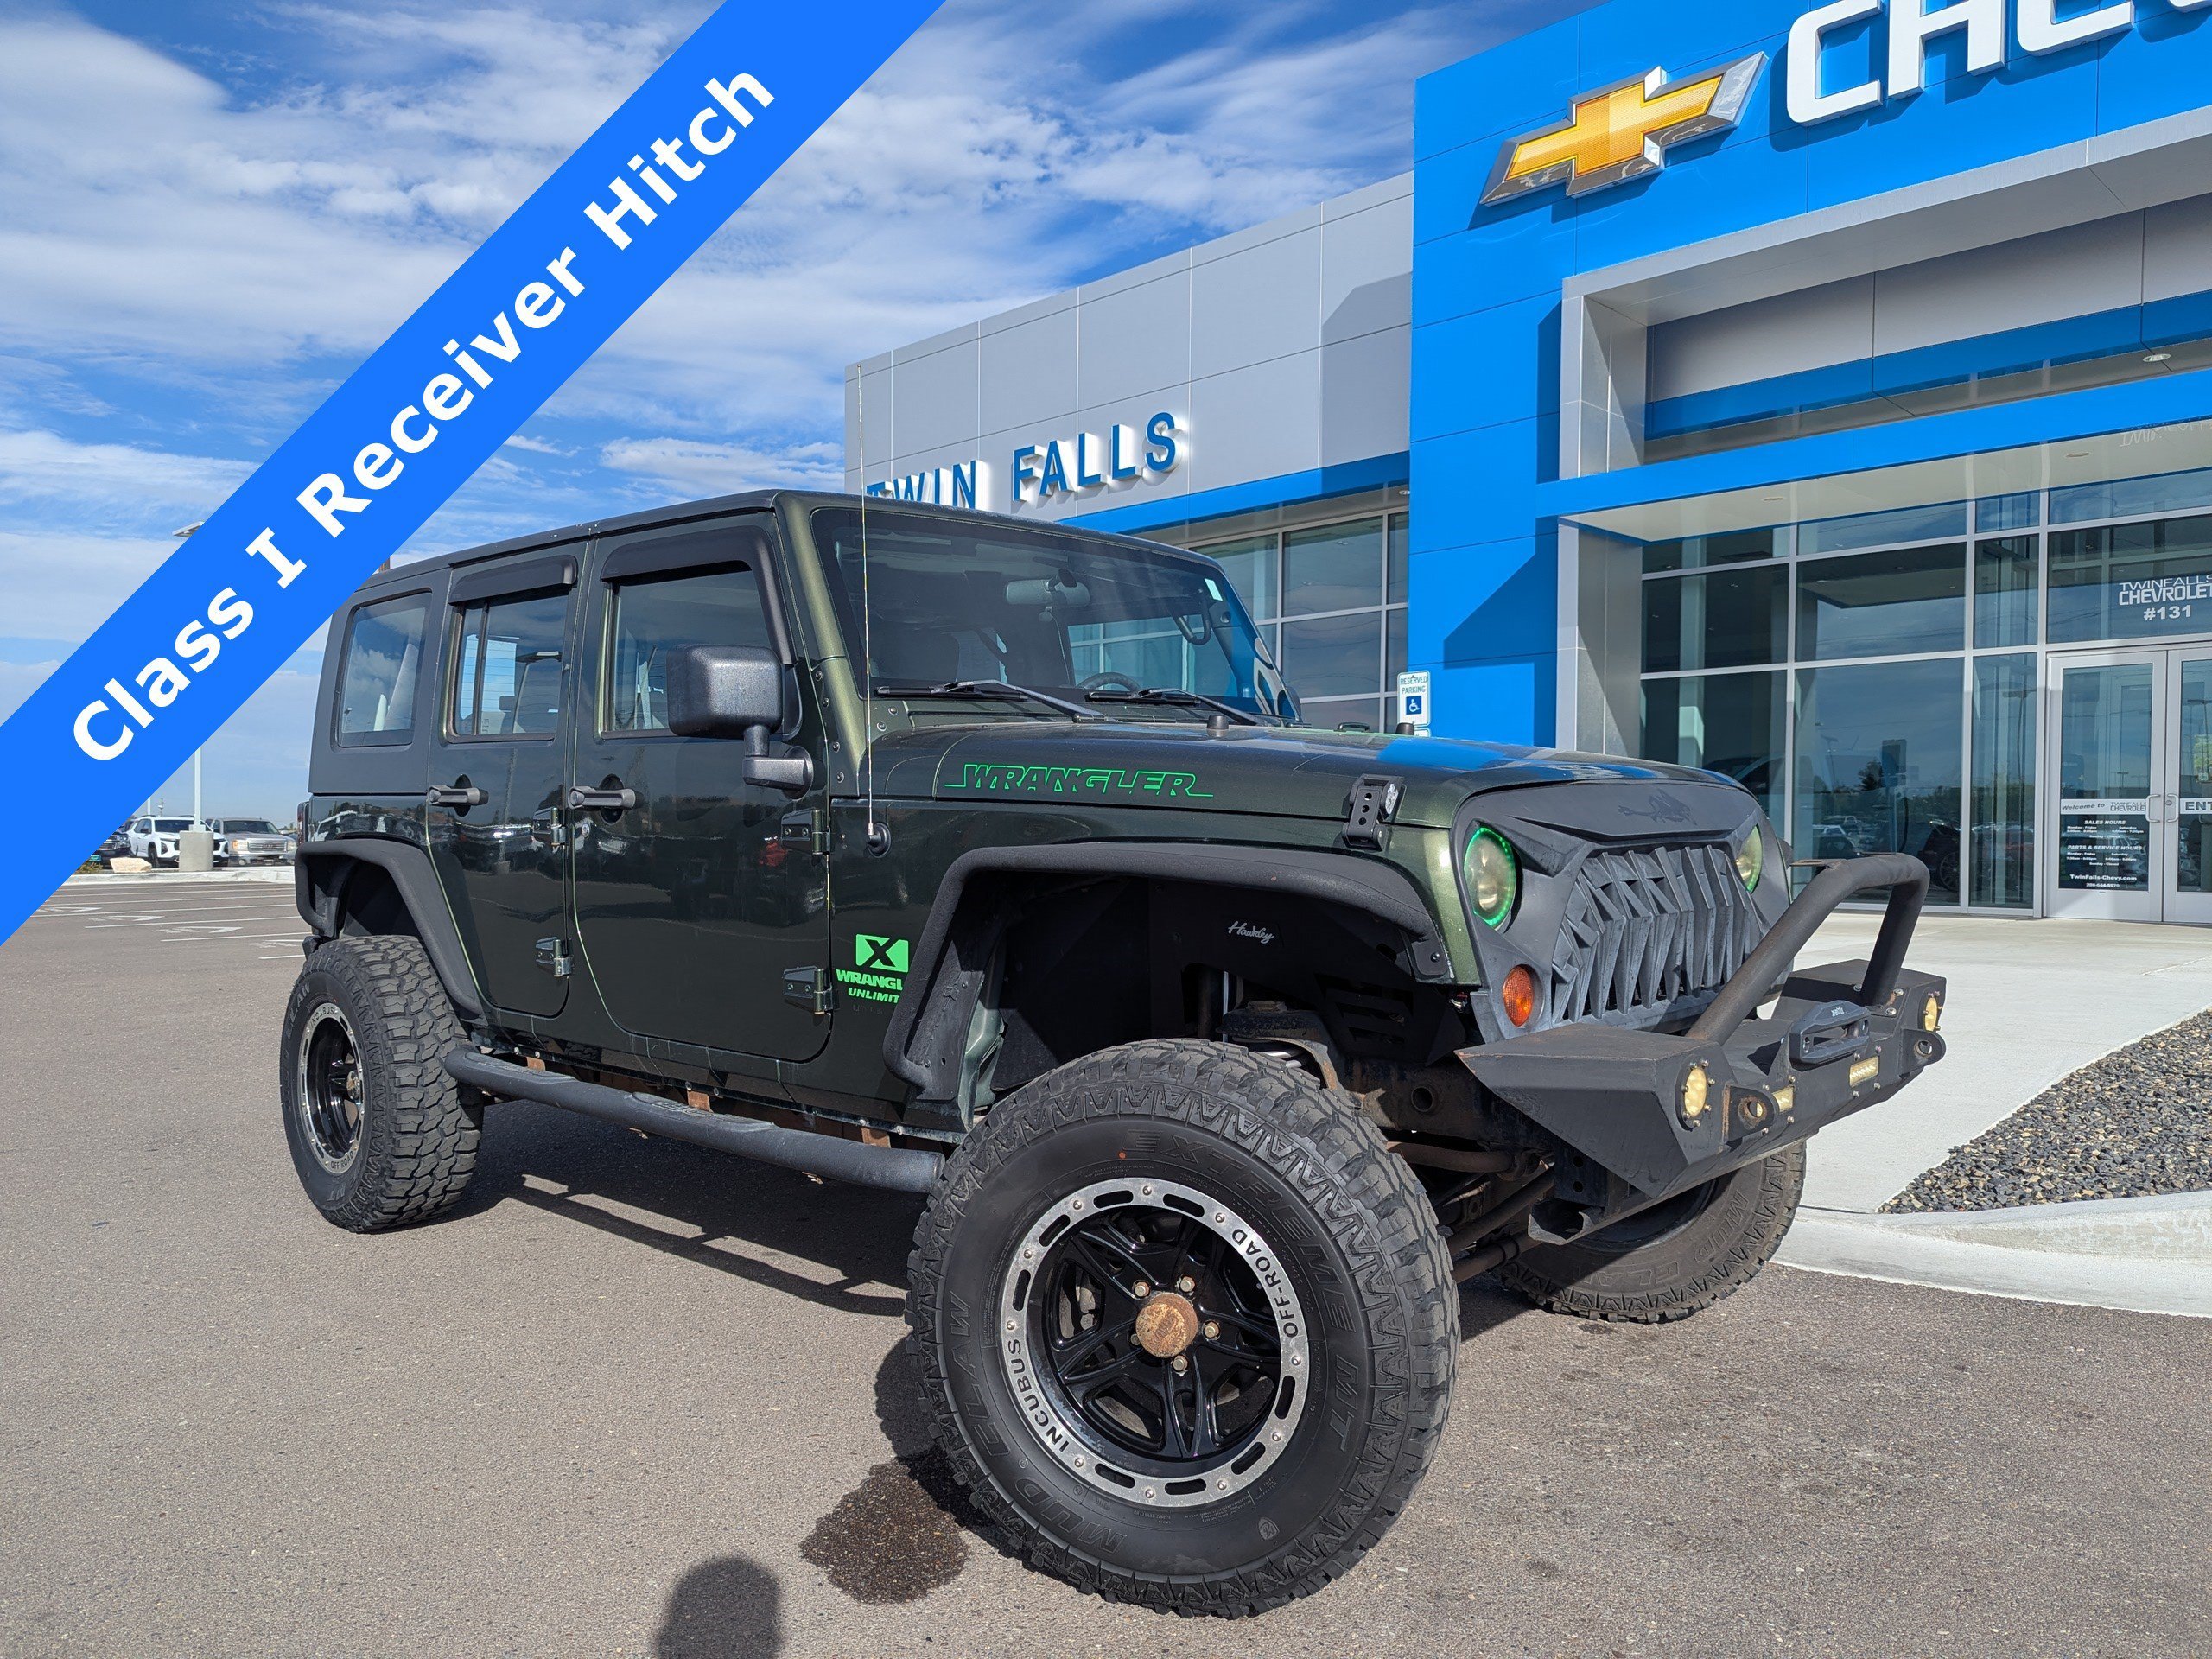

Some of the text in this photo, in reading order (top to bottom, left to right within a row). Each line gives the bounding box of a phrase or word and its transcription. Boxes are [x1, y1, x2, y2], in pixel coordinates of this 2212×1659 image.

[866, 411, 1181, 509] WIN FALLS
[2119, 582, 2212, 606] CHEVROLET
[2143, 605, 2191, 621] #131
[1400, 676, 1427, 685] RESERVED
[944, 764, 1213, 797] WRANGLER
[2062, 803, 2095, 811] Welcome
[1231, 1229, 1299, 1338] OFF-ROAD
[1007, 1338, 1071, 1452] INCUBUS
